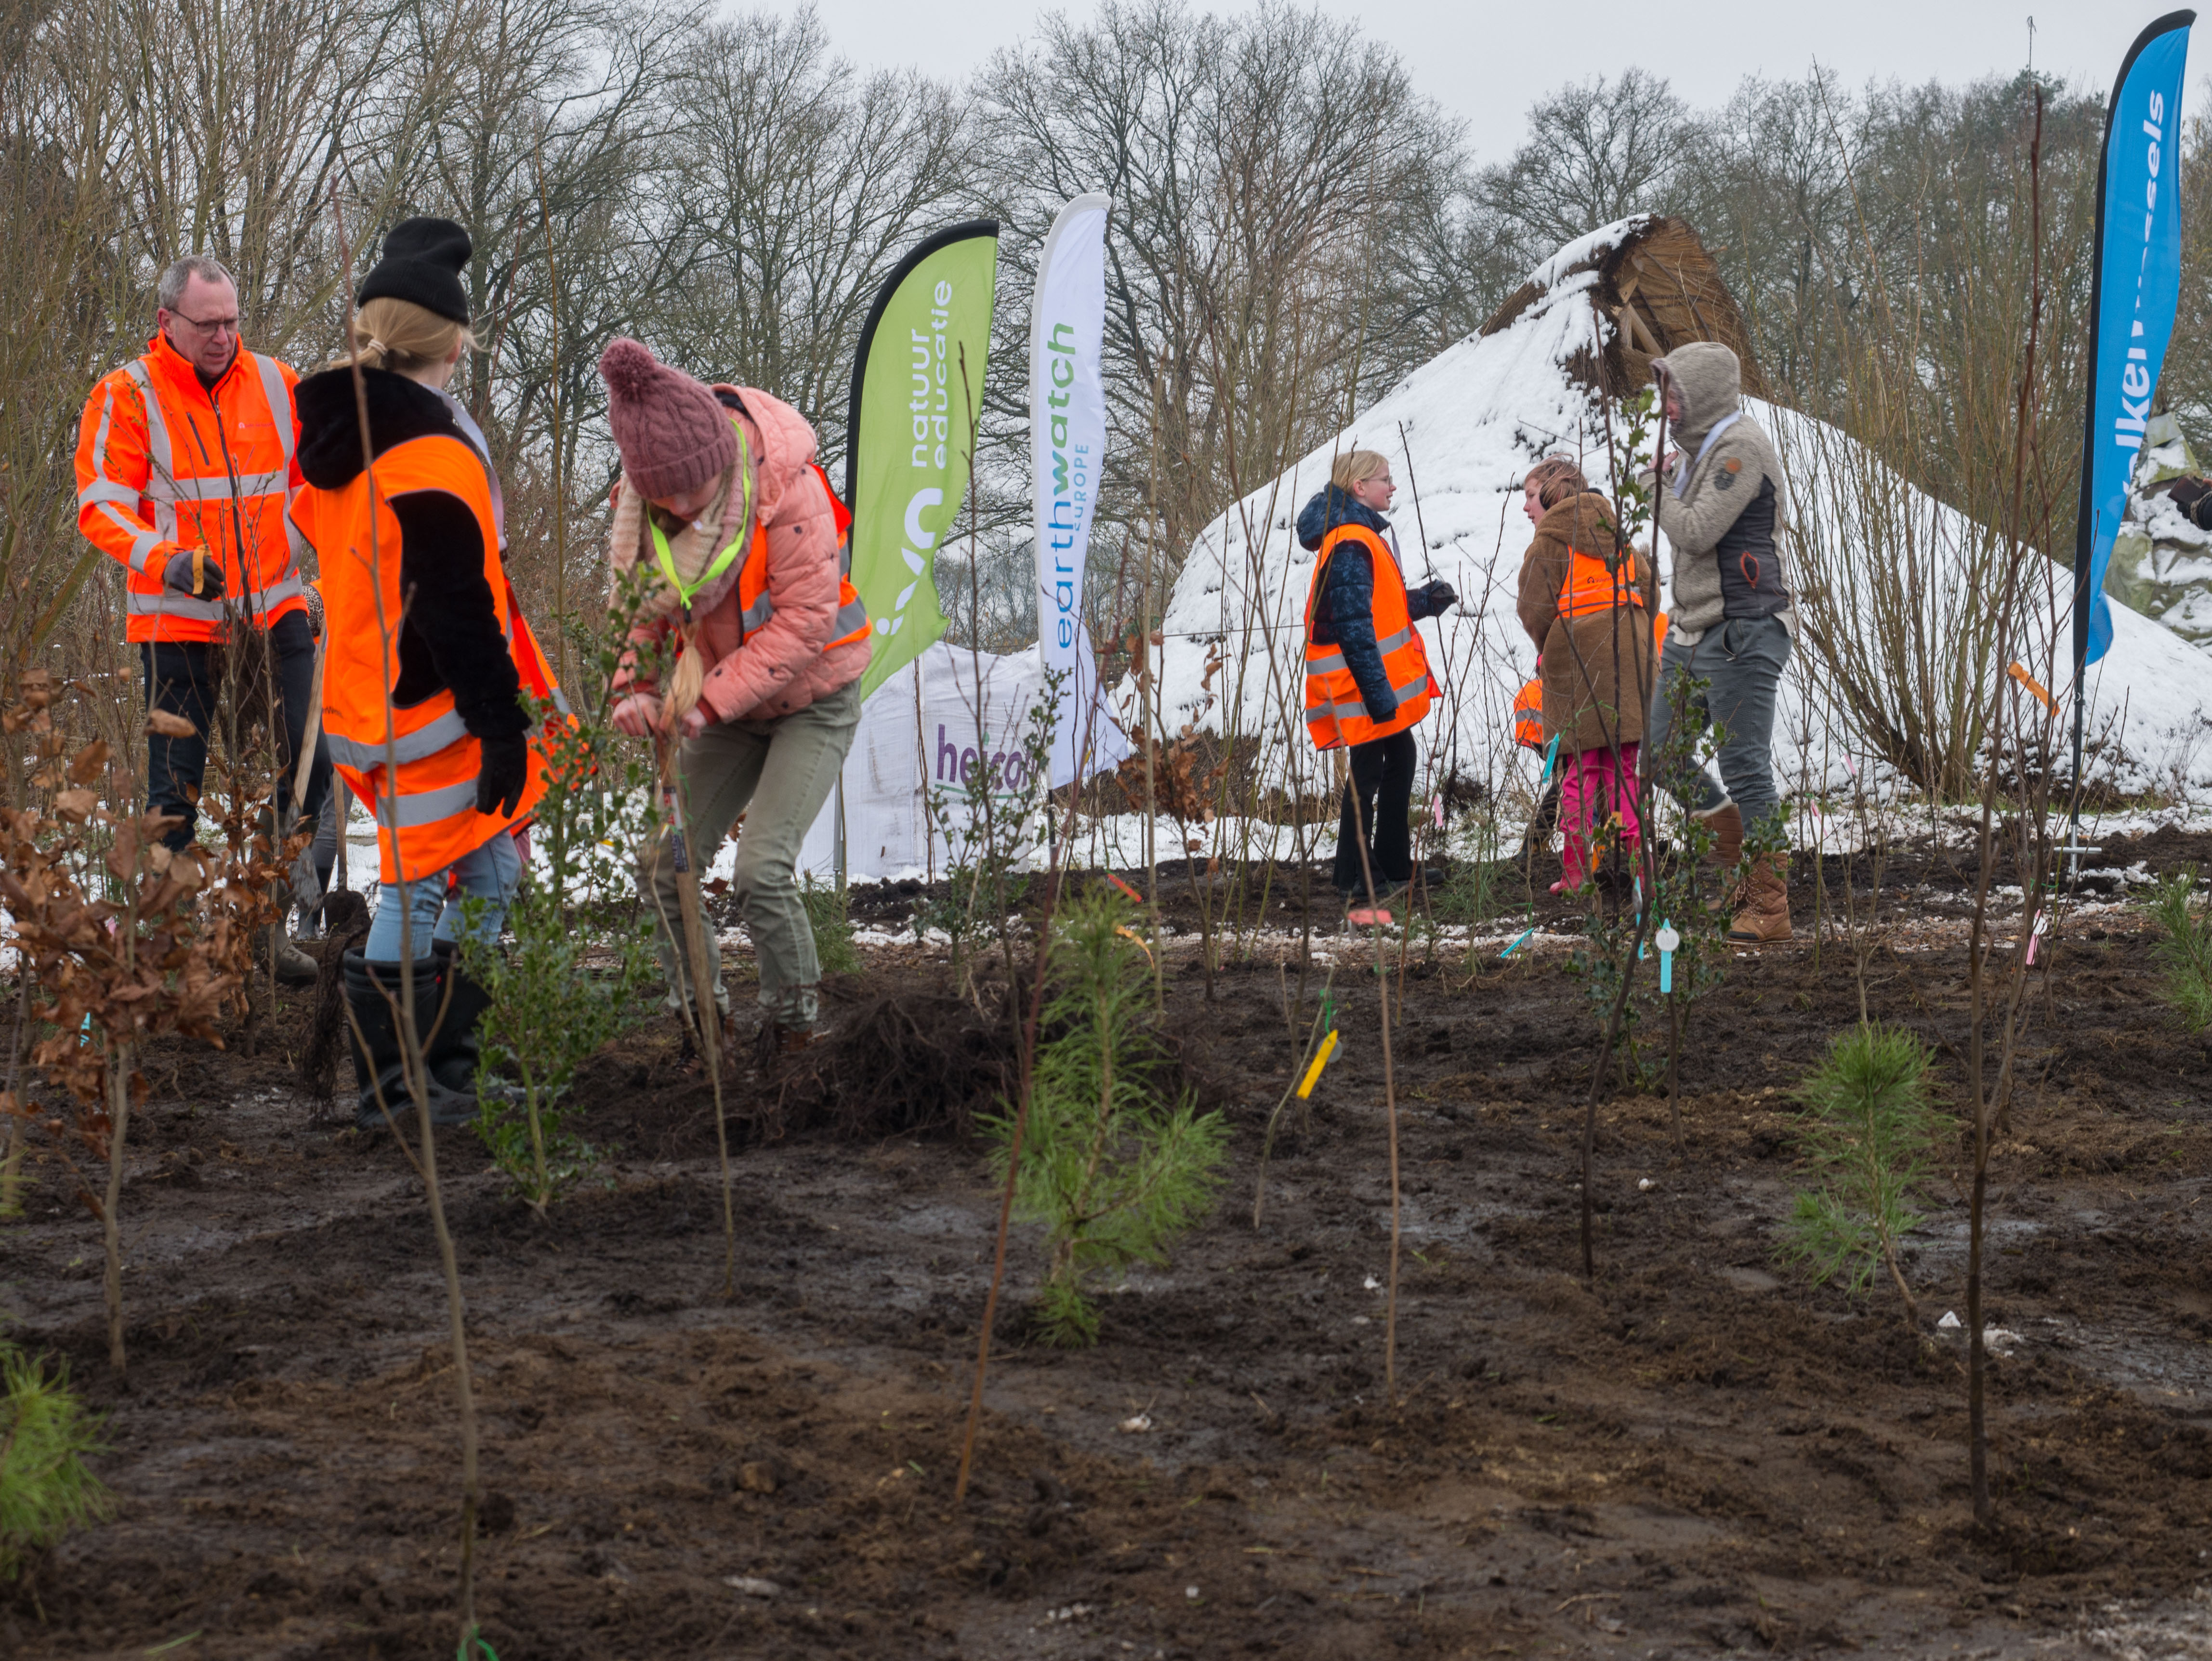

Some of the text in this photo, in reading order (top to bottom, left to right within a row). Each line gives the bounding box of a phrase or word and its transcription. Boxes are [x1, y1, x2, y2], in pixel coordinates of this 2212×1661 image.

[909, 328, 931, 468] natuur
[931, 280, 952, 470] educatie
[1047, 322, 1076, 648] earthwatch
